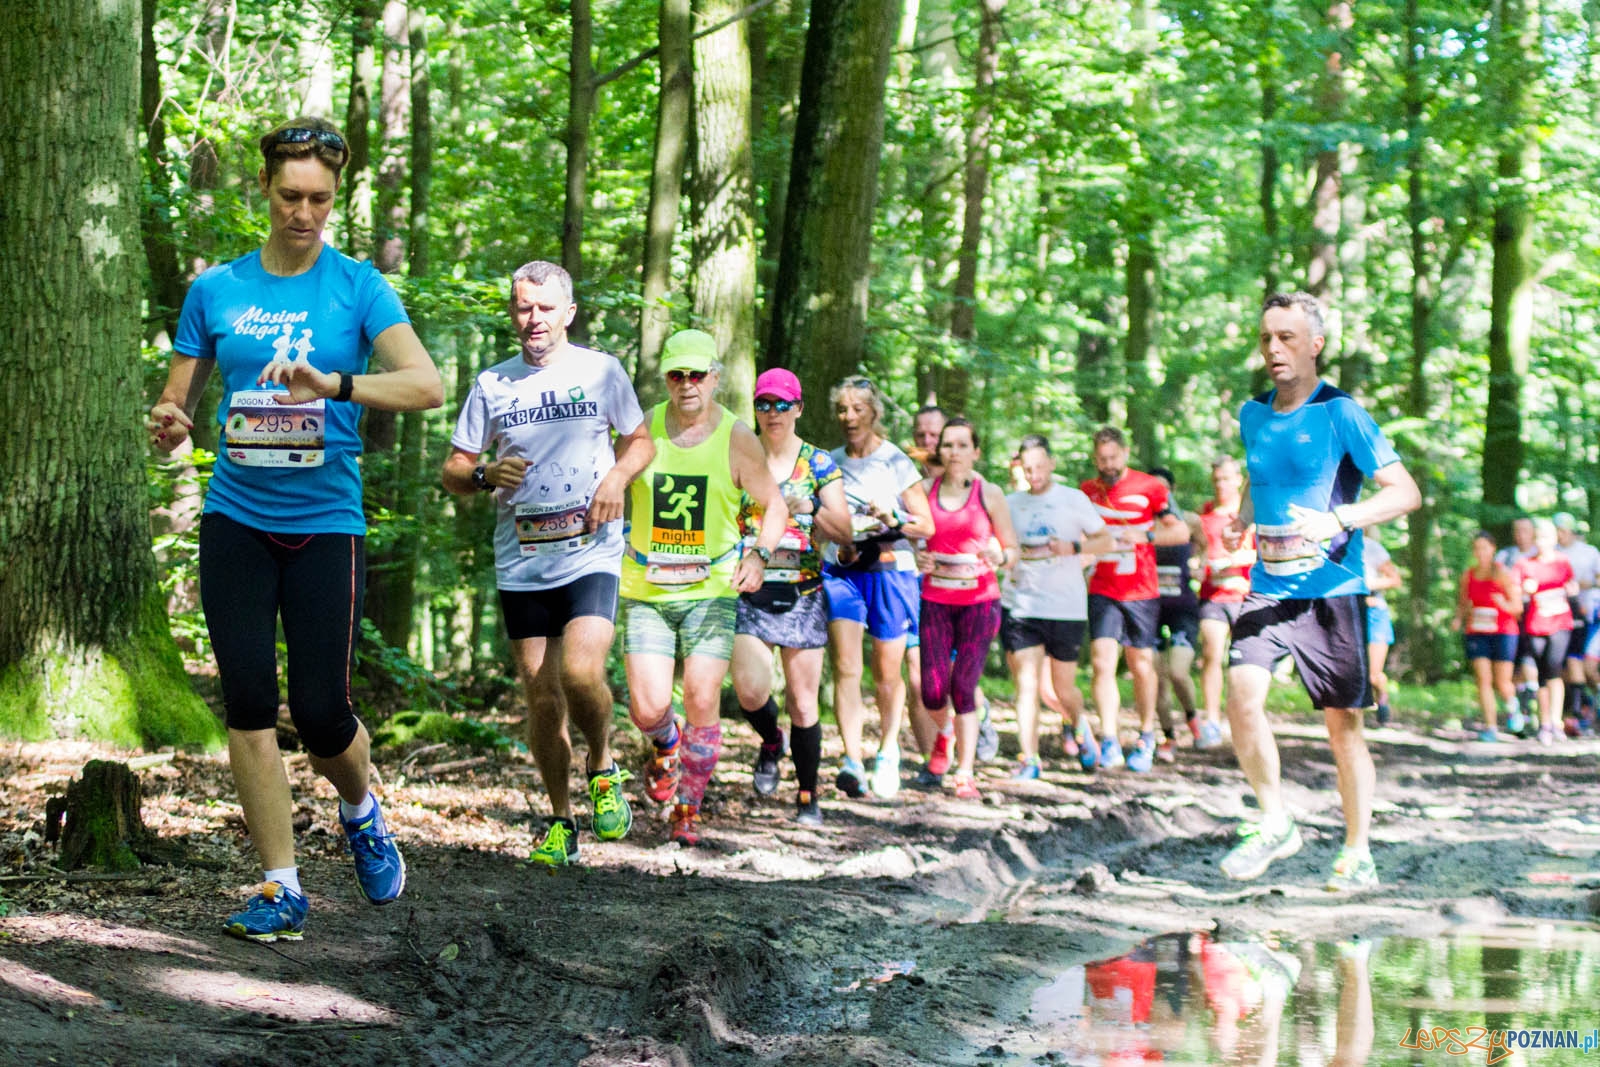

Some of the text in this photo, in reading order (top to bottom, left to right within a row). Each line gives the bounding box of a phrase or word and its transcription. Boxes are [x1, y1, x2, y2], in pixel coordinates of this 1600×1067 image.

[232, 305, 309, 327] Mosina
[234, 319, 280, 340] biega
[253, 413, 294, 433] 295
[505, 403, 597, 428] KB ZIEMEK
[538, 516, 568, 532] 258
[662, 529, 696, 544] night
[650, 541, 705, 555] runners
